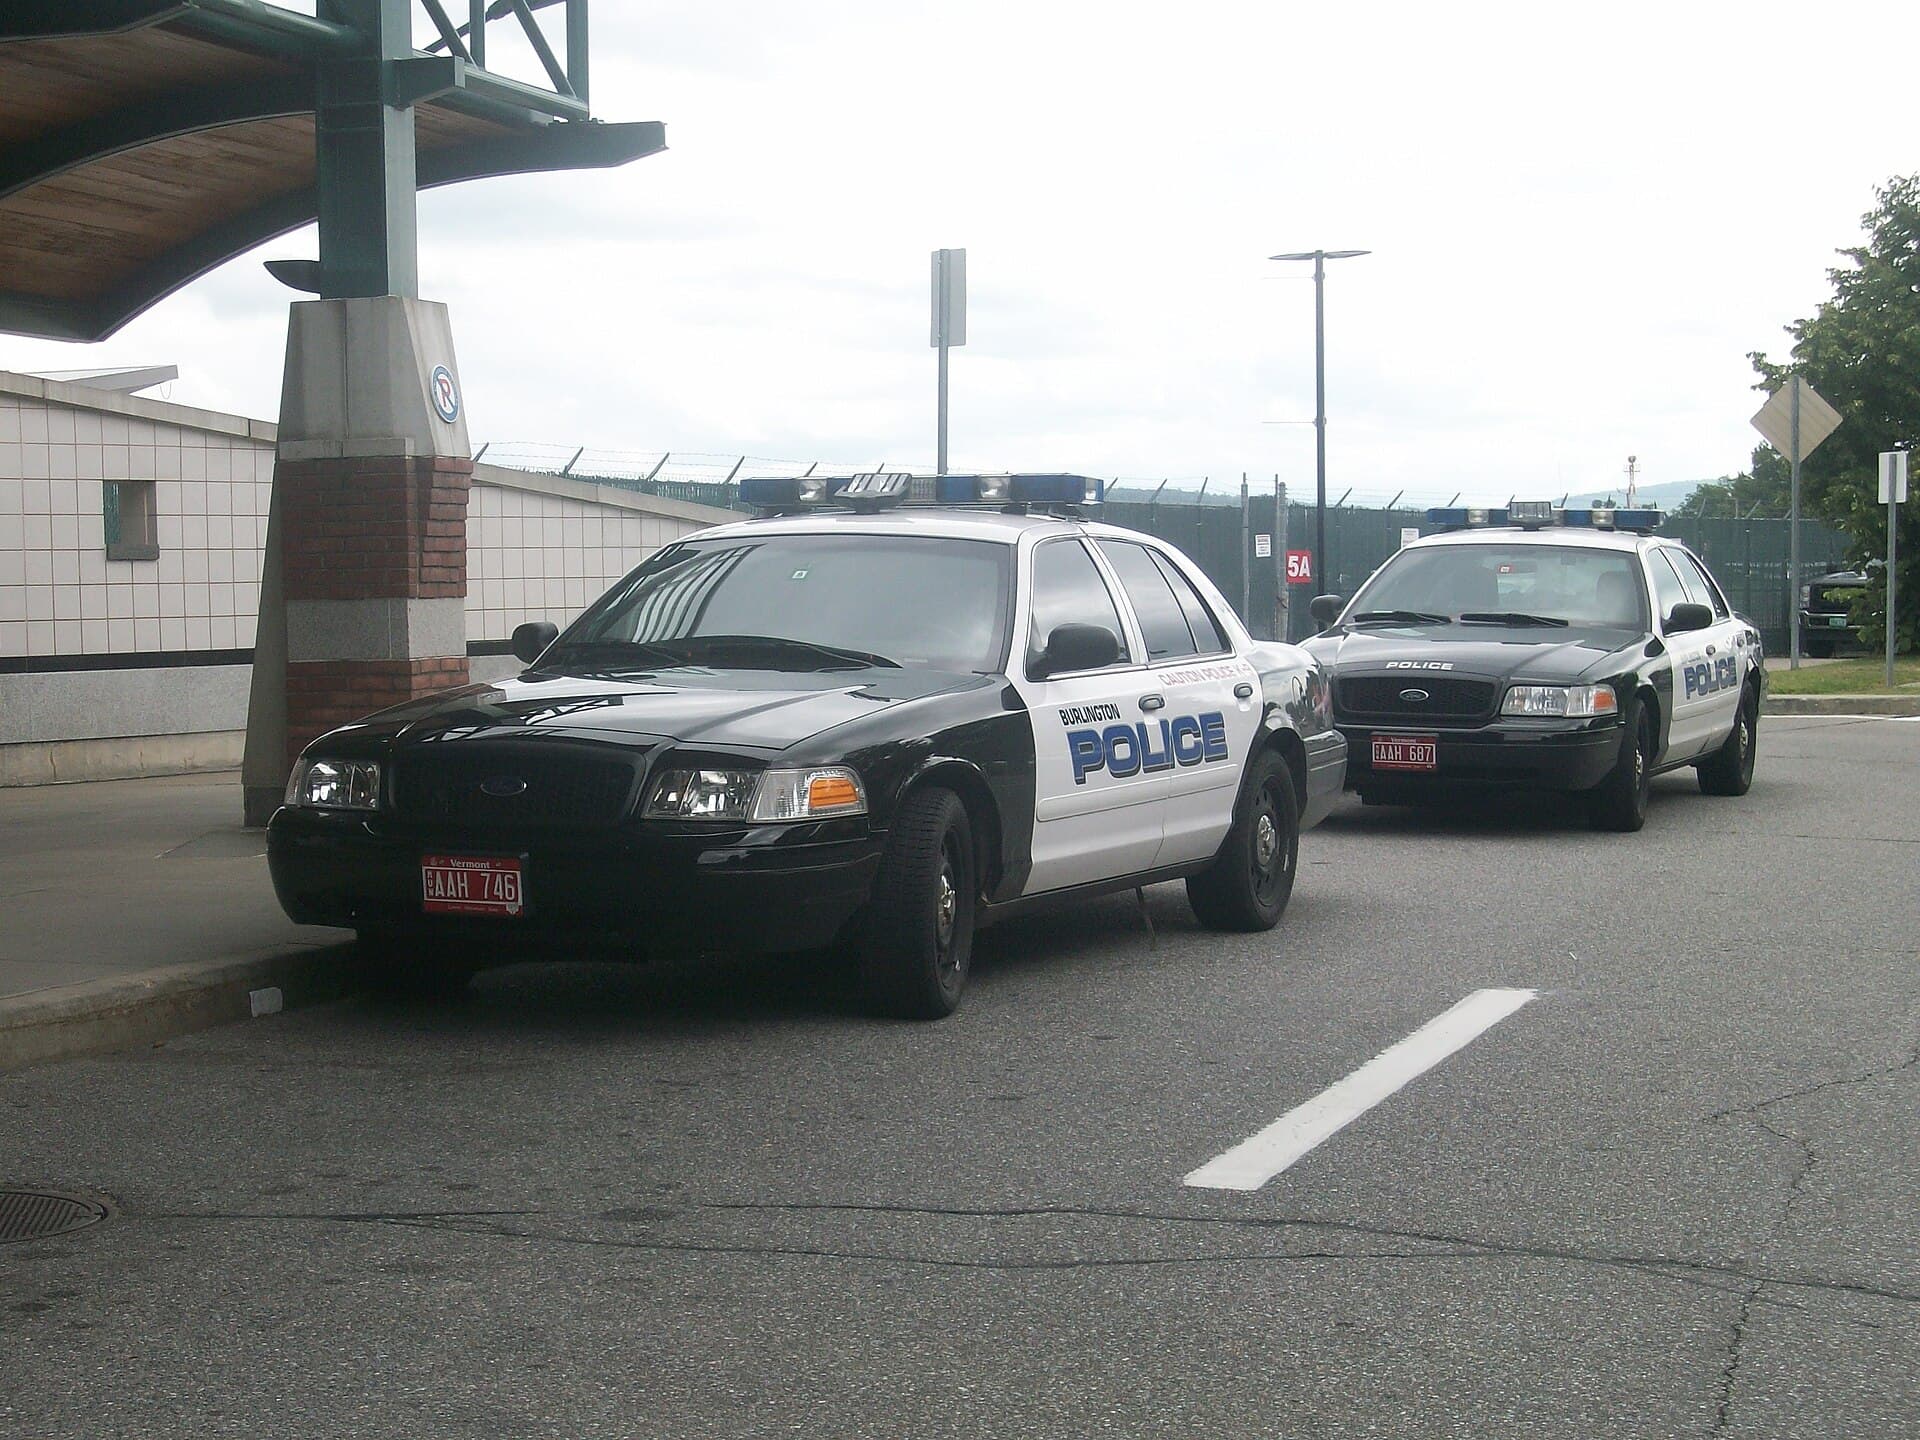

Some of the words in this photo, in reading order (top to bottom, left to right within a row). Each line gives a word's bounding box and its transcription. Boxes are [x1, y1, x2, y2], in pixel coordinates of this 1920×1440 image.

[1287, 555, 1311, 578] 5A
[1158, 670, 1206, 686] CAUTION
[1202, 665, 1235, 681] POLICE
[1386, 661, 1454, 670] POLICE
[1683, 656, 1737, 700] POLICE
[1058, 702, 1121, 726] BURLINGTON
[1066, 711, 1229, 785] POLICE
[1380, 744, 1401, 760] AAH
[1409, 745, 1431, 761] 687
[450, 859, 490, 869] Vermont
[435, 871, 469, 898] AAH
[480, 872, 515, 901] 746
